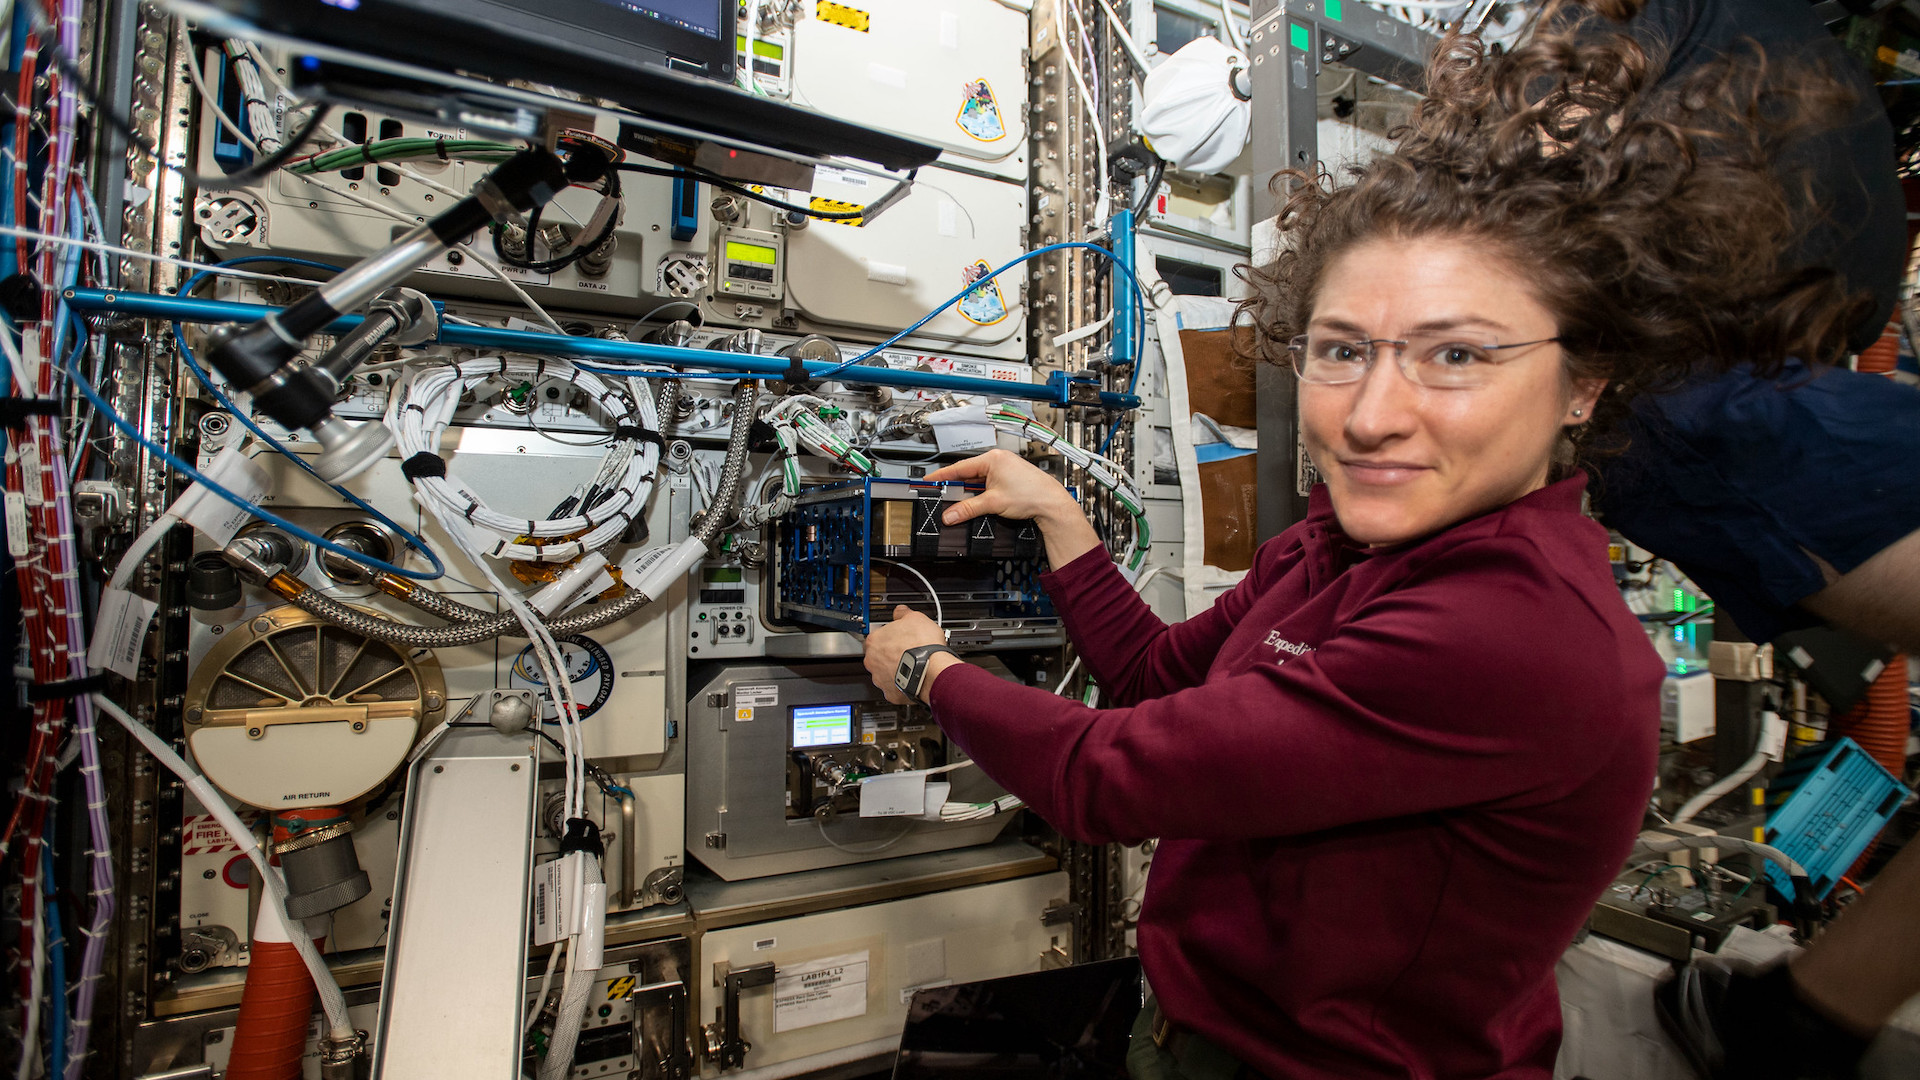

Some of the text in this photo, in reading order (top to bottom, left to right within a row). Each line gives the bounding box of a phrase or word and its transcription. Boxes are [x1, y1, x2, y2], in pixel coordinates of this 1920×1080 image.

[685, 253, 704, 261] OPEN
[501, 266, 519, 274] PWR
[578, 281, 607, 291] DATA J2
[956, 367, 983, 375] INDICATION
[1264, 629, 1313, 656] Expedi
[596, 673, 612, 704] PAYLOAD
[298, 791, 331, 799] RETURN
[196, 830, 221, 839] FIRE
[207, 837, 234, 845] LAB1P4
[801, 967, 844, 982] LAB1P4_L2
